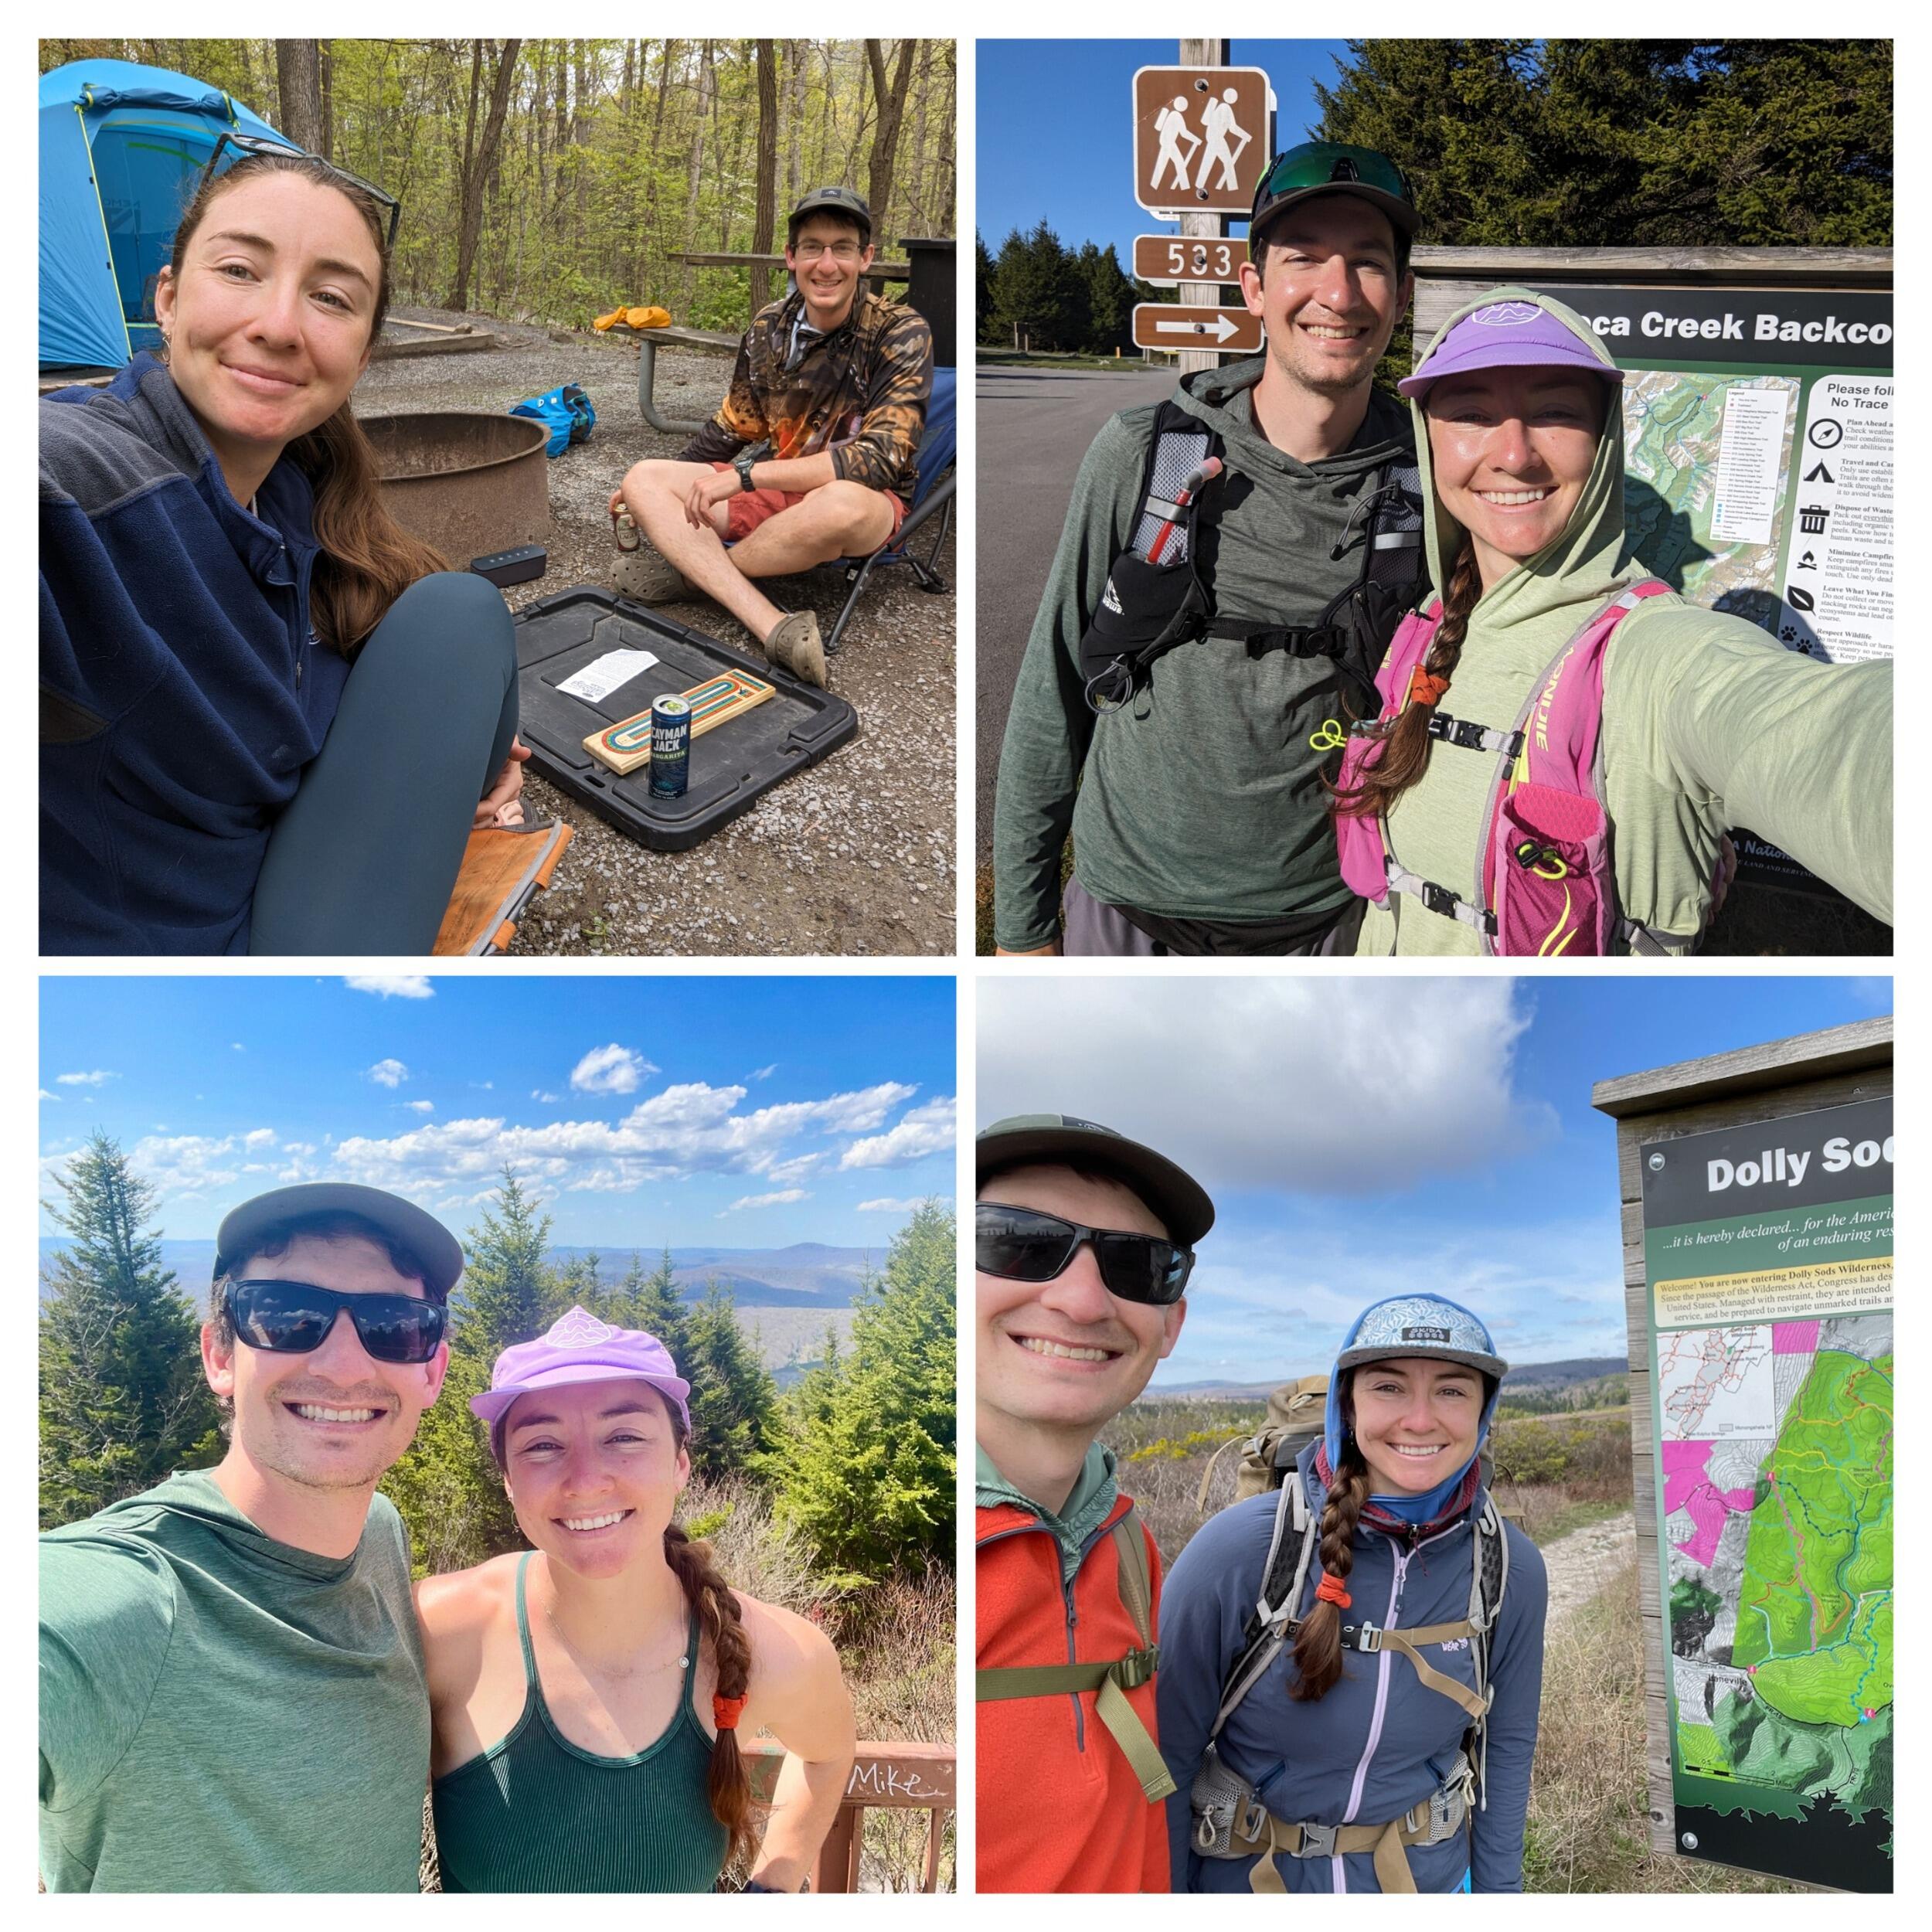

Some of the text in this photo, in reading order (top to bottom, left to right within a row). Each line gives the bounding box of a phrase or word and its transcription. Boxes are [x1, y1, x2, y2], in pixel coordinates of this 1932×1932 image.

[1168, 243, 1231, 277] 533
[1640, 311, 1745, 340] Creek
[1753, 314, 1893, 345] Backco
[1827, 383, 1870, 395] Please
[1831, 397, 1889, 410] No Trace
[1855, 482, 1881, 492] through
[1835, 504, 1862, 512] Dispose
[1832, 519, 1864, 528] including
[1828, 549, 1861, 557] Minimize
[1845, 558, 1878, 566] campfires
[1826, 564, 1859, 573] extinguish
[1821, 600, 1847, 609] stacking
[1845, 594, 1867, 603] collect
[1819, 607, 1855, 616] ecosystems
[1817, 628, 1872, 640] Respect Wildlife
[1838, 638, 1868, 647] approach
[1836, 645, 1861, 654] country
[651, 723, 687, 740] CAYMAN
[653, 738, 680, 752] JACK
[1707, 1147, 1811, 1192] Dolly
[1684, 1236, 1693, 1247] is
[1696, 1230, 1735, 1247] hereby
[1801, 1218, 1824, 1234] for
[1826, 1213, 1846, 1227] the
[1777, 1236, 1791, 1253] of
[1793, 1237, 1809, 1249] an
[1812, 1229, 1872, 1246] enduring
[1660, 1283, 1697, 1293] Welcome!
[1699, 1281, 1714, 1289] You
[1732, 1277, 1748, 1286] now
[1751, 1272, 1787, 1284] entering
[1789, 1270, 1812, 1280] Dolly
[1815, 1267, 1836, 1276] Sods
[1661, 1294, 1681, 1303] Since
[1696, 1290, 1725, 1301] passage
[1726, 1287, 1736, 1296] of
[1737, 1287, 1750, 1295] the
[1751, 1282, 1795, 1294] Wilderness
[1797, 1280, 1815, 1290] Act,
[1817, 1277, 1858, 1289] Congress
[1859, 1274, 1875, 1283] has
[1666, 1302, 1692, 1312] United
[1719, 1297, 1755, 1308] Managed
[1757, 1294, 1775, 1304] with
[1777, 1291, 1814, 1302] restraint,
[1815, 1289, 1835, 1300] they
[1852, 1283, 1890, 1295] intended
[1674, 1312, 1703, 1322] service,
[1704, 1310, 1718, 1319] and
[1719, 1309, 1729, 1318] be
[1731, 1306, 1765, 1319] prepared
[1777, 1302, 1812, 1314] navigate
[1814, 1297, 1857, 1309] unmarked
[1859, 1295, 1882, 1306] trails
[847, 1763, 940, 1797] Mike
